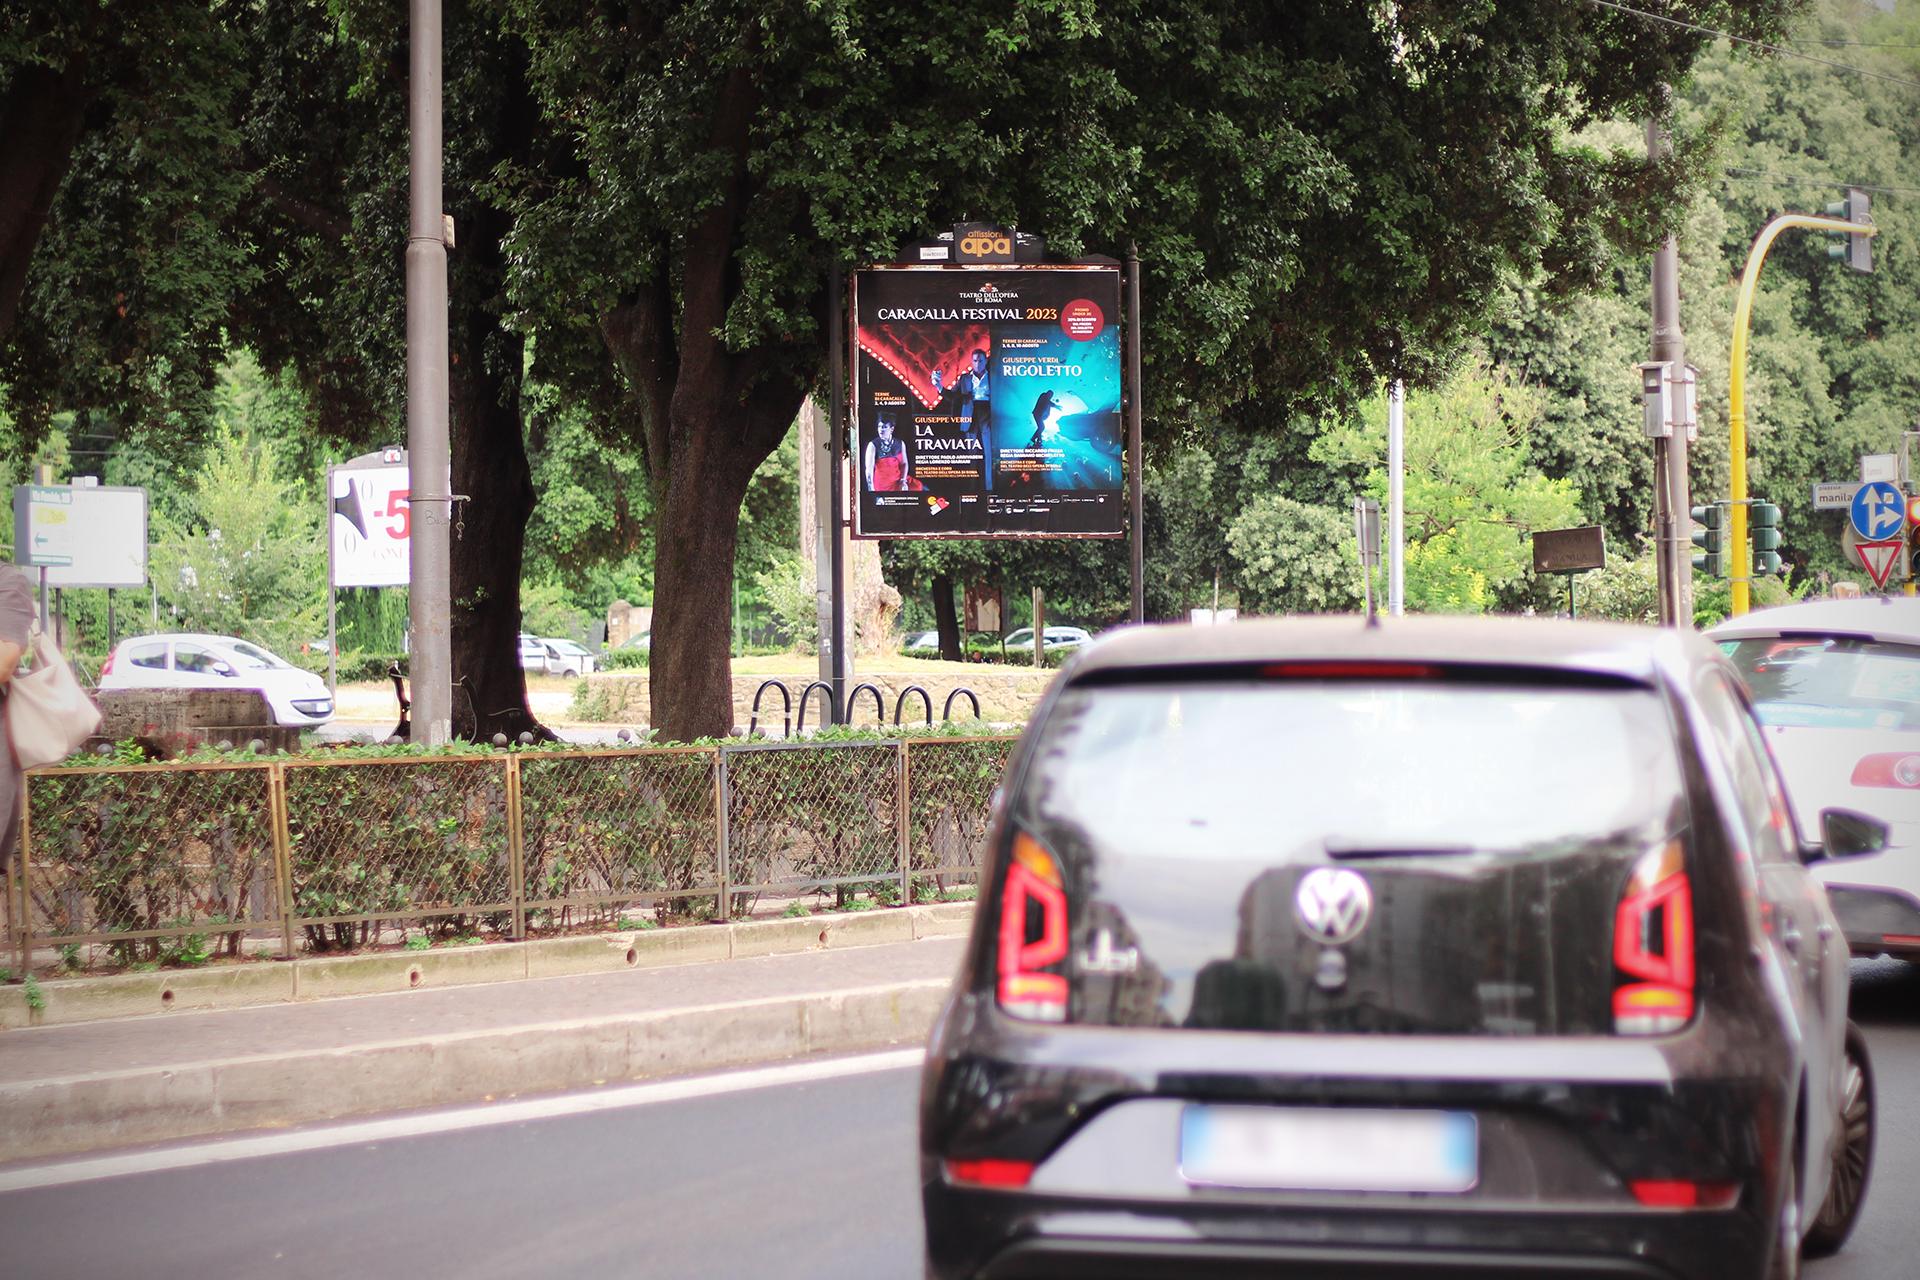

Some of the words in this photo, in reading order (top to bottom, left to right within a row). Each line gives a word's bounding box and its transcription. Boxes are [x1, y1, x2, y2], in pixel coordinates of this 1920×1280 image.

[960, 237, 1011, 258] apa
[878, 308, 960, 320] CARACALLA
[962, 308, 1024, 320] FESTIVAL
[1026, 308, 1058, 320] 2023
[1003, 365, 1082, 376] RIGOLETTO
[916, 425, 934, 436] LA
[915, 439, 982, 450] TRAVIATA
[1819, 493, 1852, 502] manila
